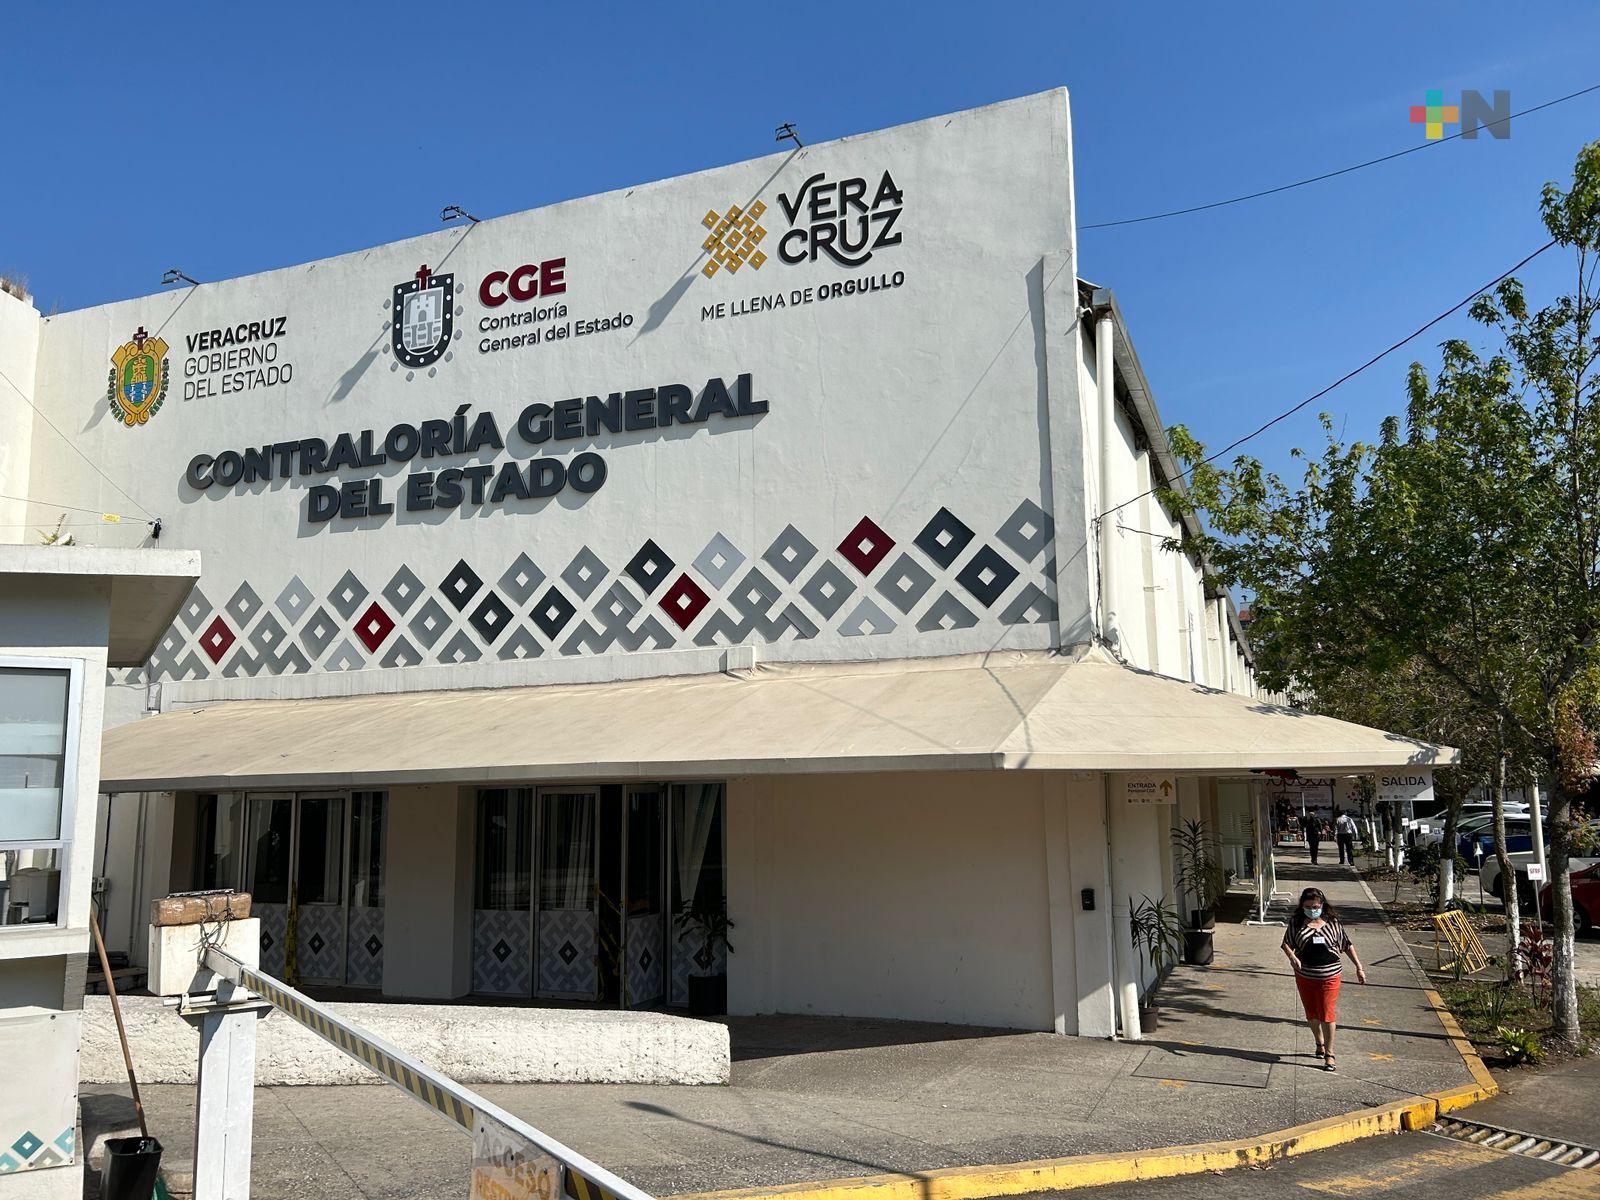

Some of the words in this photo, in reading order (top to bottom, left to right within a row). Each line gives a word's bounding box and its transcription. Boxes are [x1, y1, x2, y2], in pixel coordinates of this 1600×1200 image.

[777, 169, 903, 226] VERA
[778, 208, 902, 266] CRUZ
[479, 257, 566, 308] CGE
[701, 303, 725, 321] ME
[731, 293, 786, 317] LLENA
[790, 288, 813, 307] DE
[817, 271, 905, 300] ORGULLO
[186, 317, 287, 353] VERACRUZ
[479, 302, 568, 333] Contraloría
[479, 329, 541, 353] General
[545, 323, 570, 341] del
[575, 312, 634, 338] Estado
[183, 380, 217, 401] DEL
[222, 363, 293, 395] ESTADO
[184, 342, 278, 377] GOBIERNO
[186, 404, 504, 489] CONTRALORÍA
[518, 373, 769, 445] GENERAL
[308, 479, 394, 522] DEL
[407, 452, 607, 512] ESTADO
[1382, 776, 1426, 786] SALIDA
